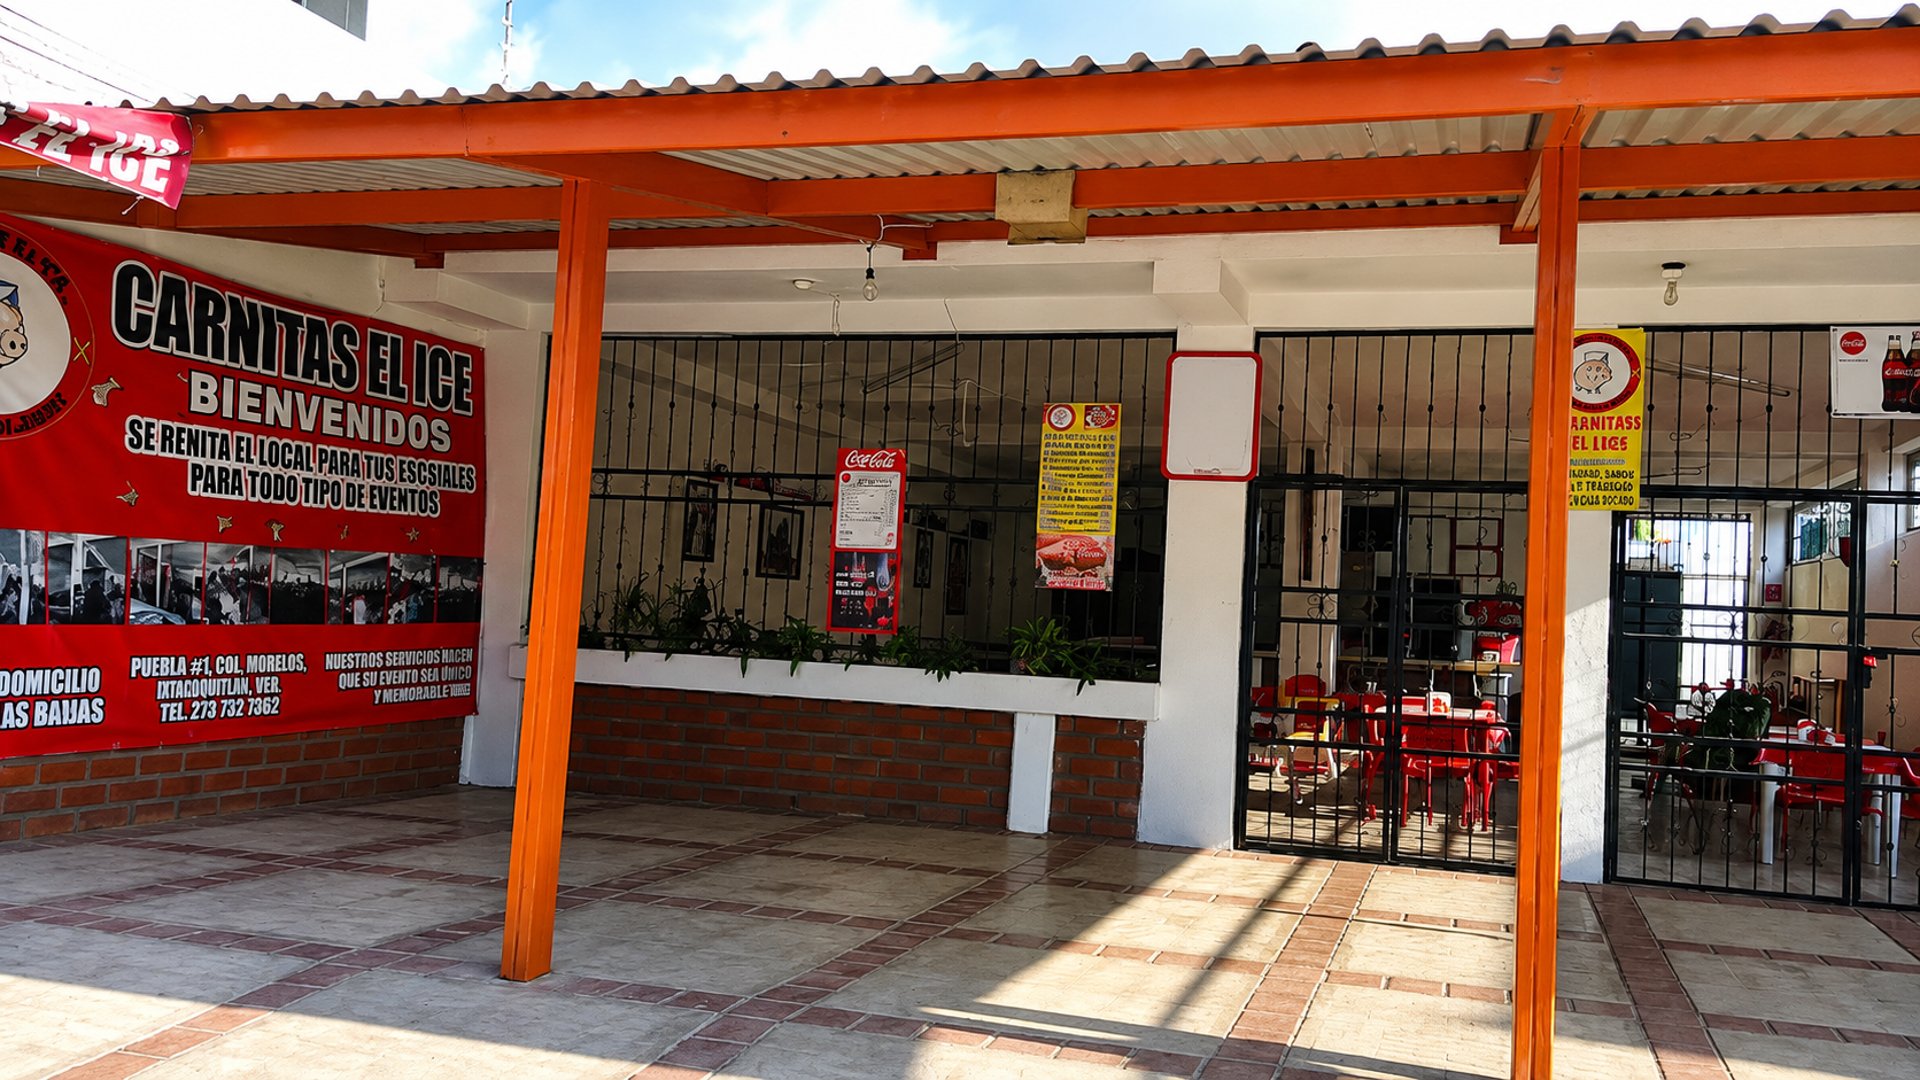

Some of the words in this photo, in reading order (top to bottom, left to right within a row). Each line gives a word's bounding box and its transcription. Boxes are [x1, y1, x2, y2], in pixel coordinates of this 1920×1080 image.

[112, 260, 360, 392] CARNITAS
[366, 328, 408, 403] EL
[413, 340, 474, 417] ICE
[189, 369, 452, 452] BIENVENIDOS
[127, 417, 156, 453] SE
[235, 433, 255, 466] EL
[258, 436, 314, 474] LOCAL
[317, 445, 362, 479] PARA
[364, 453, 395, 483] TUS
[190, 462, 245, 497] PARA
[247, 469, 298, 503] TODO
[301, 476, 342, 508] TIPO
[345, 481, 365, 509] DE
[369, 484, 439, 516] EVENTOS
[130, 656, 187, 678] PUEBLA
[325, 651, 384, 670] NUESTROS
[385, 649, 440, 667] SERVICIOS
[0, 667, 101, 697] DOMICILIO
[255, 676, 282, 694] VER.
[338, 671, 361, 690] QUE
[362, 670, 378, 688] SU
[379, 669, 418, 686] EVENTO
[420, 667, 440, 683] SEA
[373, 689, 382, 705] Y
[382, 684, 449, 704] MEMORABLE
[0, 701, 29, 728] AS
[159, 702, 188, 722] TEL.
[189, 700, 217, 720] 273
[220, 698, 245, 718] 732
[248, 696, 280, 716] 7362
